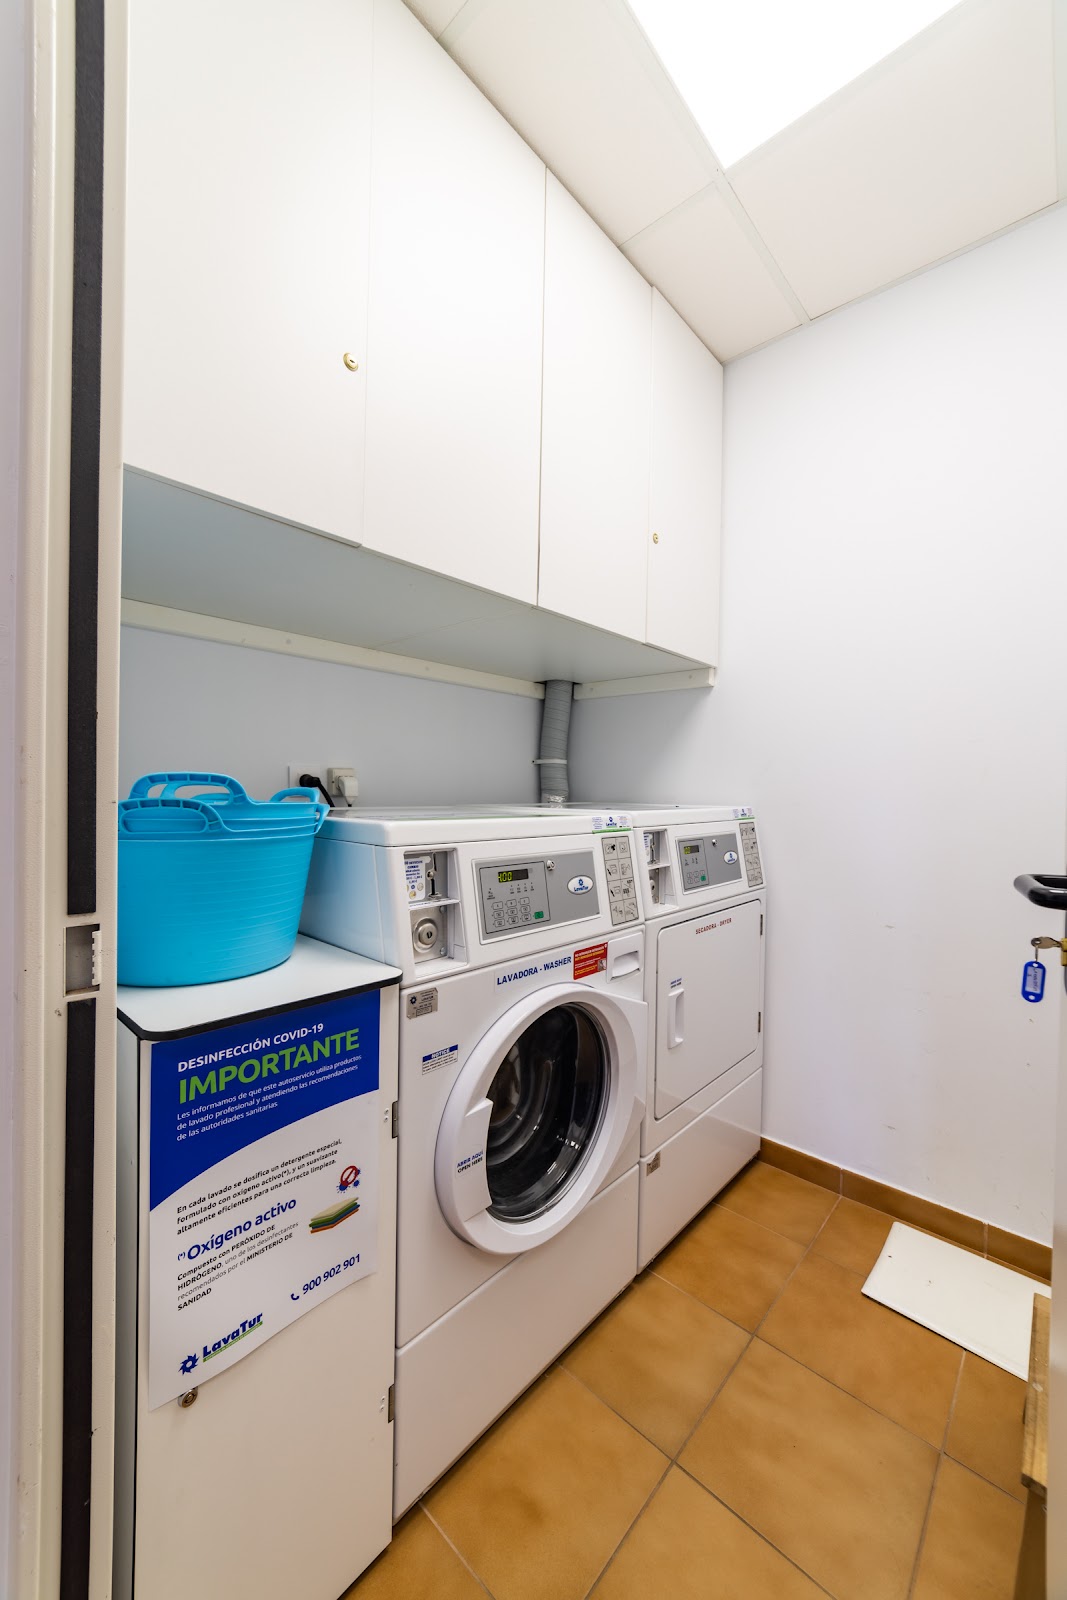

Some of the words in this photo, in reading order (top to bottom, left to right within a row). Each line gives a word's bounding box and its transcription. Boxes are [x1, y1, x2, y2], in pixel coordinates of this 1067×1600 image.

[696, 923, 716, 934] SECADORA
[720, 918, 731, 926] DRYER
[497, 967, 538, 985] LAVADORA
[544, 956, 572, 971] WASHER
[178, 1038, 270, 1072] DESINFECCIÓN
[274, 1023, 324, 1045] COVID-19
[180, 1028, 360, 1104] IMPORTANTE
[431, 1047, 450, 1058] NOTICE
[177, 1111, 190, 1120] Les
[192, 1094, 237, 1115] informamos
[248, 1088, 262, 1097] que
[263, 1083, 277, 1092] este
[278, 1070, 315, 1087] autoservicio
[316, 1064, 333, 1075] utiliza
[334, 1055, 362, 1070] productos
[177, 1122, 187, 1130] de
[189, 1114, 214, 1126] lavado
[215, 1098, 255, 1119] profesional
[256, 1098, 261, 1106] y
[262, 1085, 298, 1102] atendiendo
[299, 1081, 308, 1089] las
[309, 1064, 358, 1085] recomendaciones
[177, 1133, 186, 1141] de
[189, 1128, 199, 1137] las
[201, 1112, 244, 1133] autoridades
[246, 1101, 278, 1117] sanitarias
[177, 1206, 187, 1214] En
[189, 1197, 206, 1209] cada
[208, 1184, 232, 1199] lavado
[234, 1181, 241, 1189] se
[243, 1169, 270, 1184] dosifica
[281, 1151, 315, 1168] detergente
[317, 1139, 342, 1153] especial,
[457, 1158, 470, 1168] ABRIR
[458, 1163, 471, 1173] OPEN
[472, 1156, 483, 1166] HERE
[177, 1202, 216, 1224] formulado
[218, 1196, 231, 1205] con
[232, 1182, 260, 1198] oxígeno
[306, 1150, 337, 1166] suavizante
[177, 1214, 216, 1235] altamente
[218, 1196, 253, 1215] eficientes
[254, 1188, 269, 1200] para
[270, 1182, 282, 1190] una
[283, 1172, 309, 1185] correcta
[311, 1160, 336, 1174] limpieza.
[177, 1256, 217, 1281] Compuesto
[219, 1249, 230, 1258] con
[231, 1230, 265, 1251] PERÓXIDO
[267, 1225, 275, 1233] DE
[187, 1234, 252, 1260] Oxígeno
[255, 1200, 296, 1225] activo
[224, 1254, 237, 1264] uno
[247, 1244, 256, 1252] los
[257, 1222, 298, 1246] desinfectantes
[177, 1271, 227, 1301] recomendados
[227, 1263, 238, 1273] por
[240, 1258, 246, 1266] el
[246, 1238, 283, 1261] MINISTERIO
[285, 1233, 293, 1241] DE
[302, 1276, 321, 1294] 900
[323, 1264, 341, 1282] 902
[343, 1254, 360, 1271] 901
[177, 1288, 212, 1311] SANIDAD
[203, 1313, 263, 1358] LavaTur
